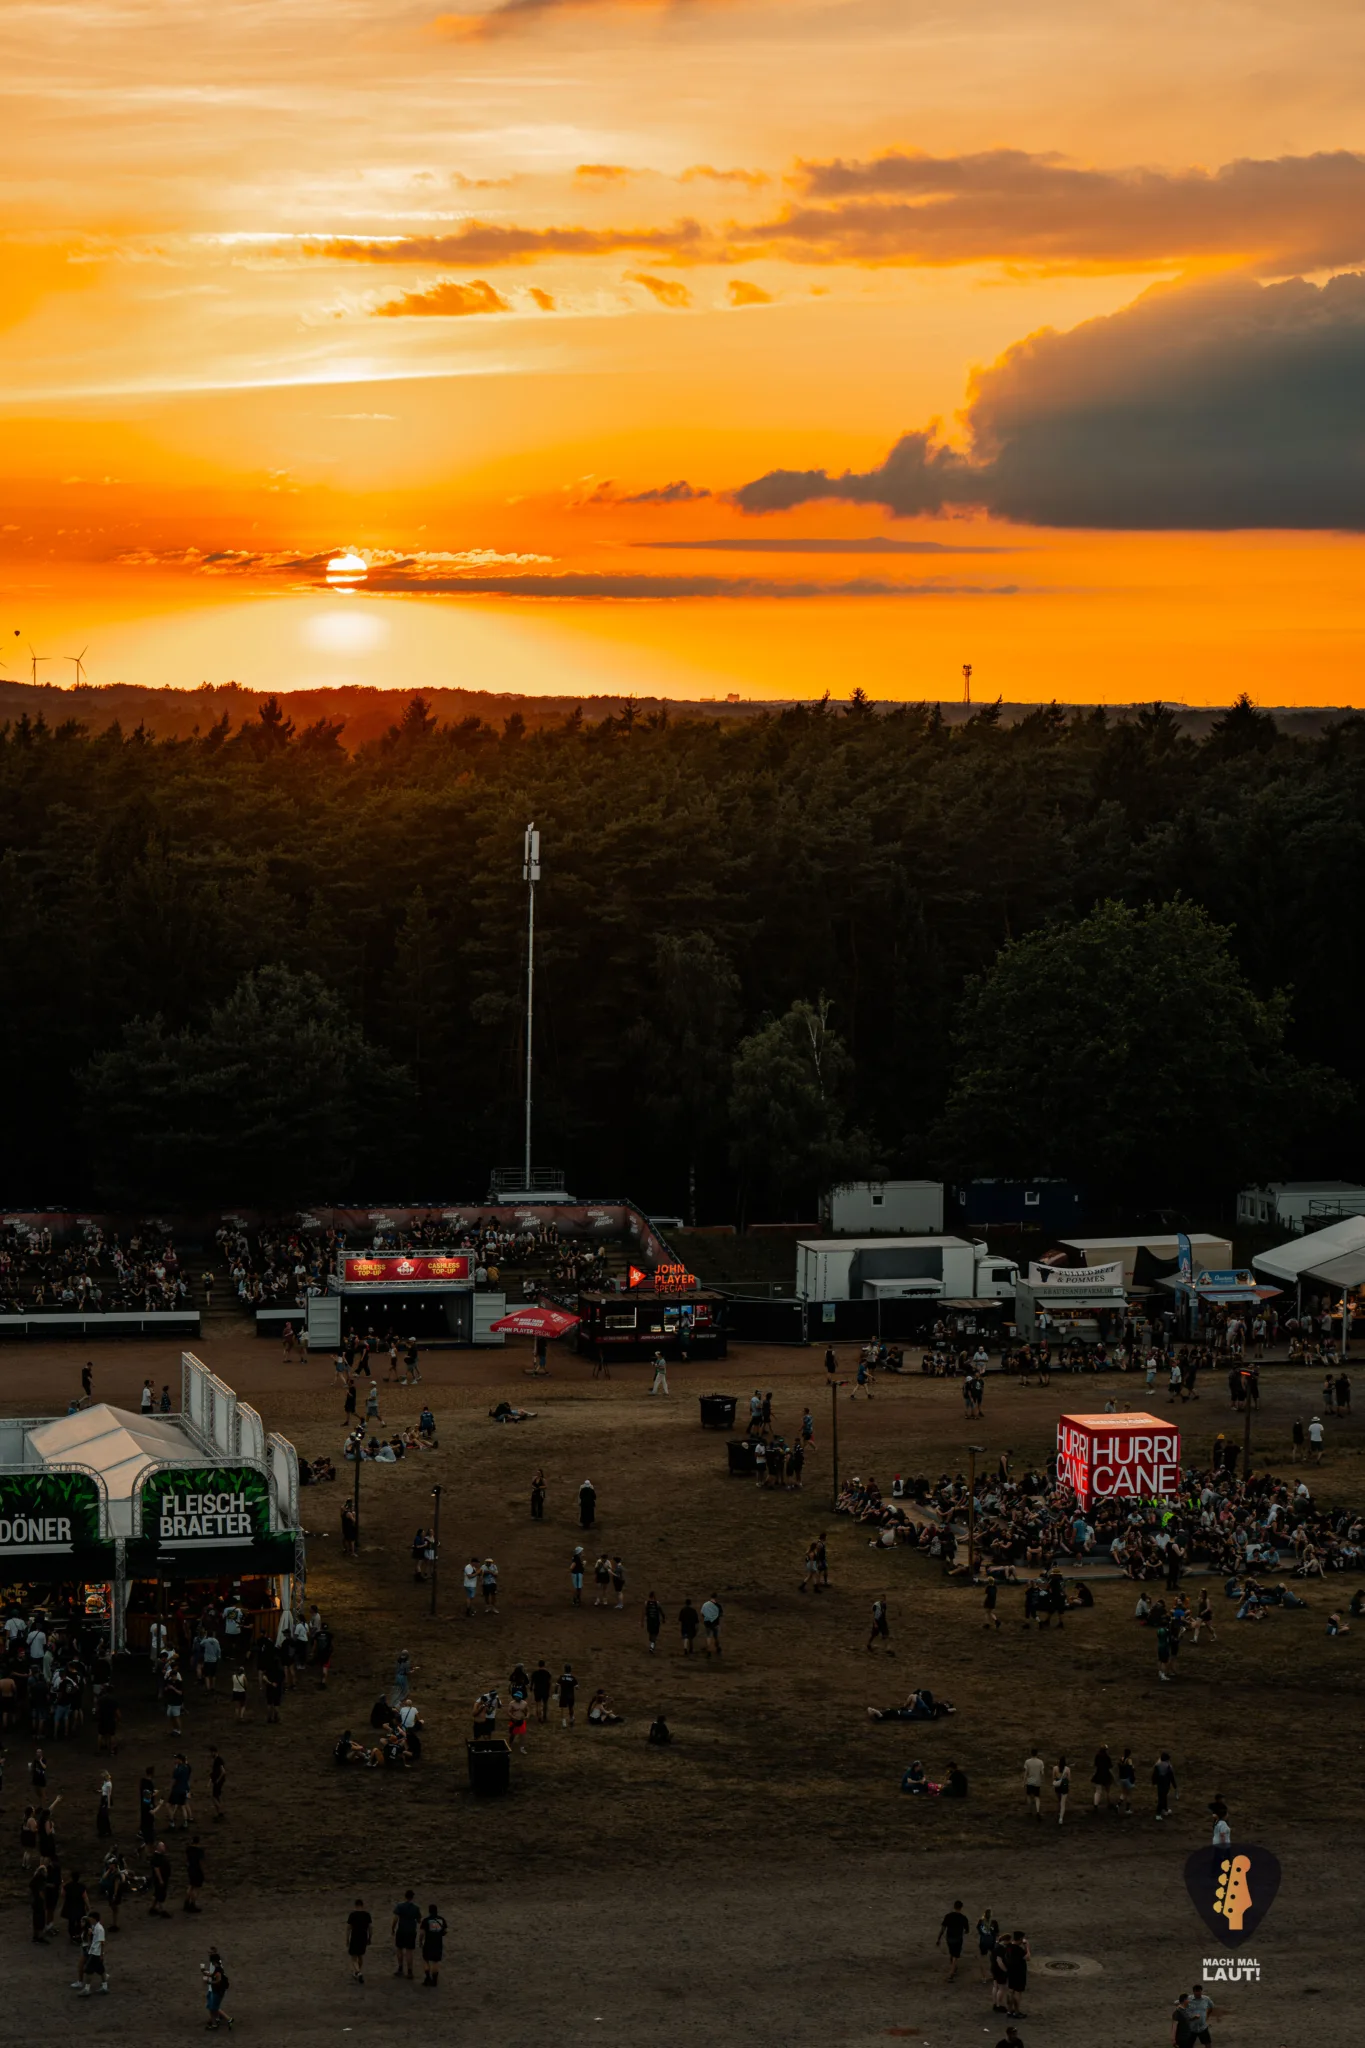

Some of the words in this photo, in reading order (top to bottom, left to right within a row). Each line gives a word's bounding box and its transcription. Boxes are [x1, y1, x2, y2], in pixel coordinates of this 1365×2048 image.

[654, 1264, 685, 1274] JOHN
[654, 1274, 695, 1284] PLAYER
[1065, 1275, 1105, 1283] POMMES
[654, 1284, 688, 1293] SPECIAL
[1057, 1423, 1089, 1464] HURRI
[1092, 1435, 1178, 1466] HURRI
[1056, 1452, 1088, 1495] CANE
[1092, 1464, 1177, 1496] CANE
[161, 1492, 253, 1516] FLEISCH-
[0, 1513, 72, 1543] DÖNER
[160, 1513, 252, 1537] BRAETER
